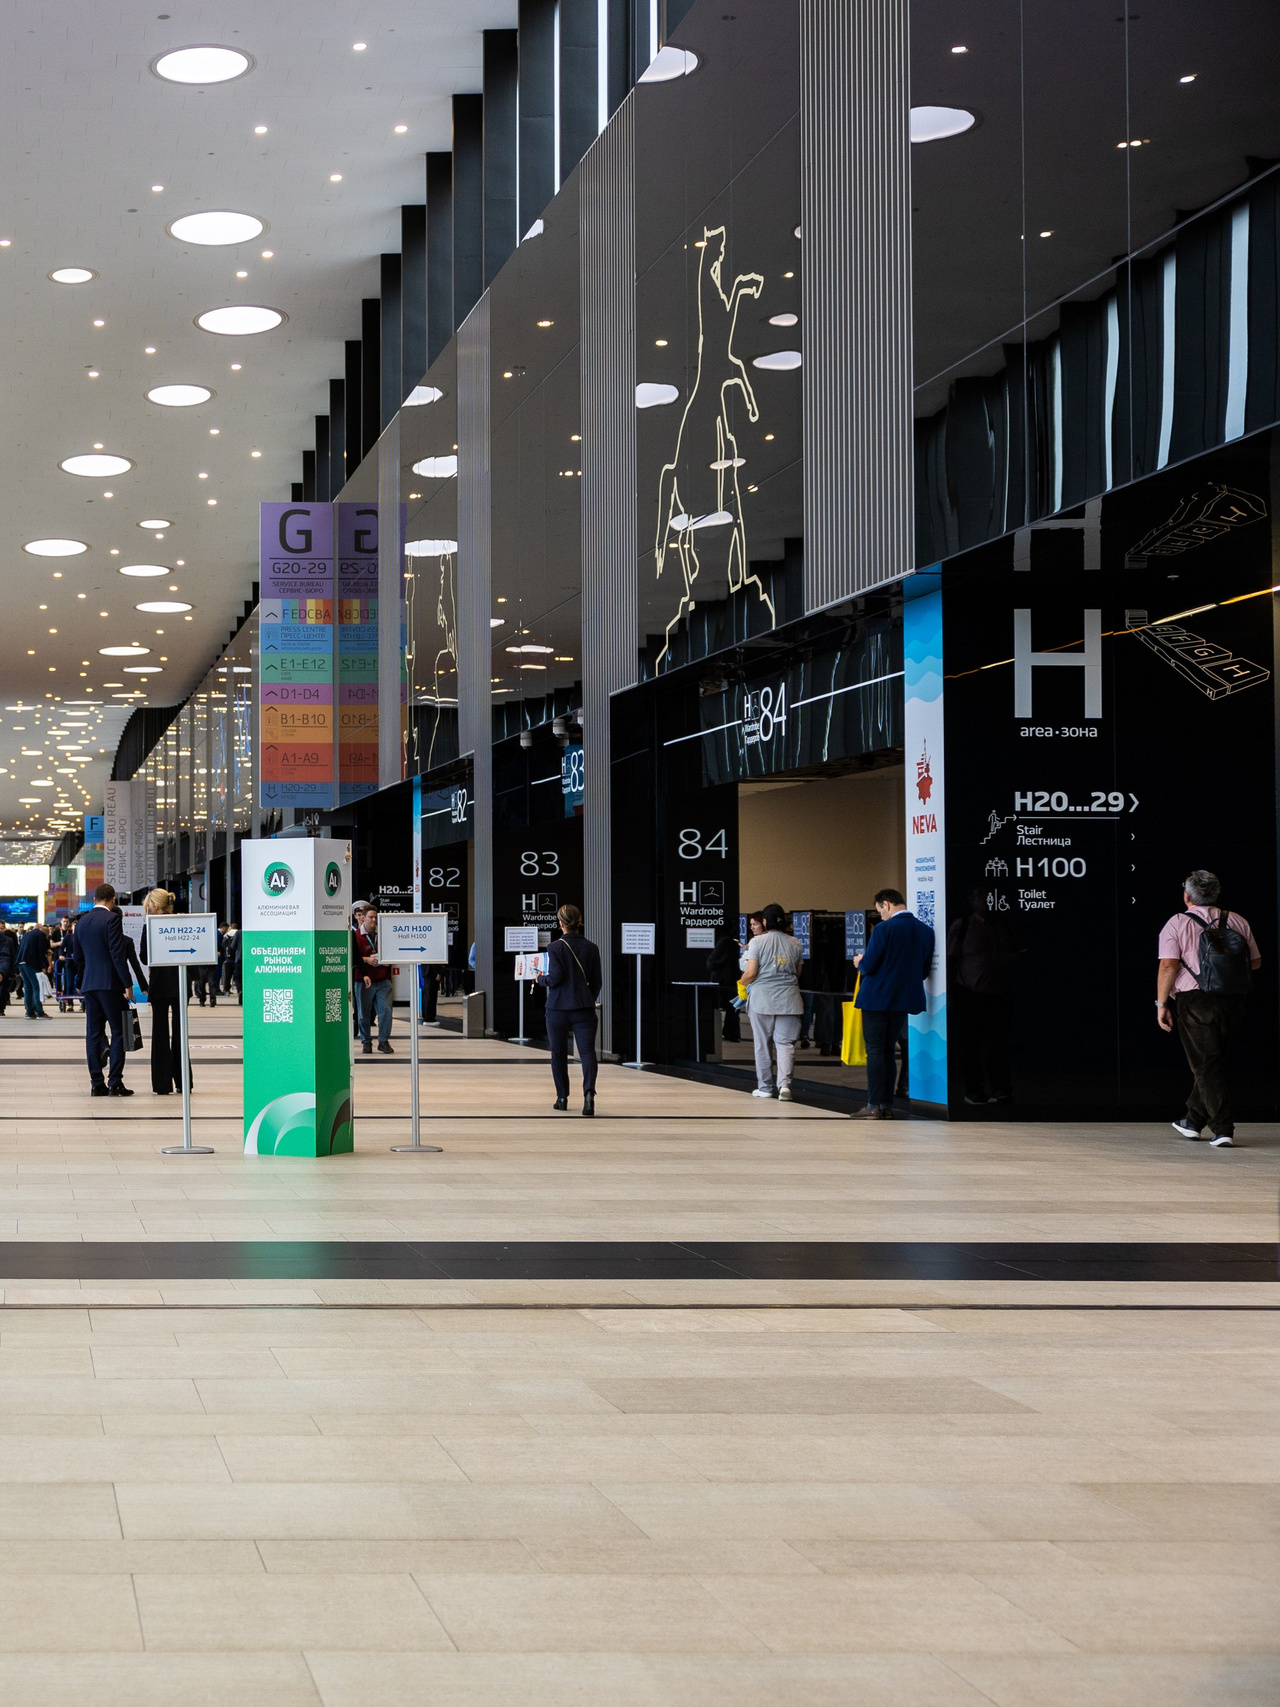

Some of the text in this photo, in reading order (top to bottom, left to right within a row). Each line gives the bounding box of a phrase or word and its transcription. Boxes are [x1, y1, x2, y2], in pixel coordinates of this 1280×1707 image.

[279, 509, 312, 554] G
[272, 562, 327, 574] G20-29
[280, 659, 326, 669] E1-E12
[1014, 609, 1102, 718] H
[280, 688, 319, 699] D1-D4
[760, 682, 787, 741] 84
[280, 714, 326, 725] B1-B10
[281, 753, 319, 763] A1-A9
[268, 784, 317, 793] H H20-29
[457, 788, 467, 823] 82
[1014, 792, 1125, 812] H20...29
[90, 817, 99, 830] F
[913, 813, 937, 835] NEVA
[1017, 825, 1043, 835] Stair
[678, 828, 728, 859] 84
[1017, 836, 1071, 846] Лестница
[119, 819, 127, 884] СЕРВИС-БЮРО
[107, 839, 116, 884] SERVICE
[520, 851, 560, 876] 83
[429, 867, 460, 887] 82
[379, 885, 413, 894] H20...2
[680, 881, 697, 902] H
[1019, 889, 1047, 899] Toilet
[522, 894, 536, 911] H
[1019, 900, 1055, 910] Туалет
[680, 906, 724, 916] Wardrobe
[680, 917, 724, 927] Гардероб
[852, 913, 865, 935] 83
[177, 926, 206, 934] H22-24
[251, 947, 306, 955] ОБЪЕДИНЯЕМ
[319, 947, 348, 955] ОБЪЕДИНЯЕМ
[264, 956, 293, 964] РЫНОК
[325, 956, 341, 964] РЫНОК
[254, 965, 302, 973] АЛЮМИНИЯ
[321, 965, 346, 973] АЛЮМИНИЯ
